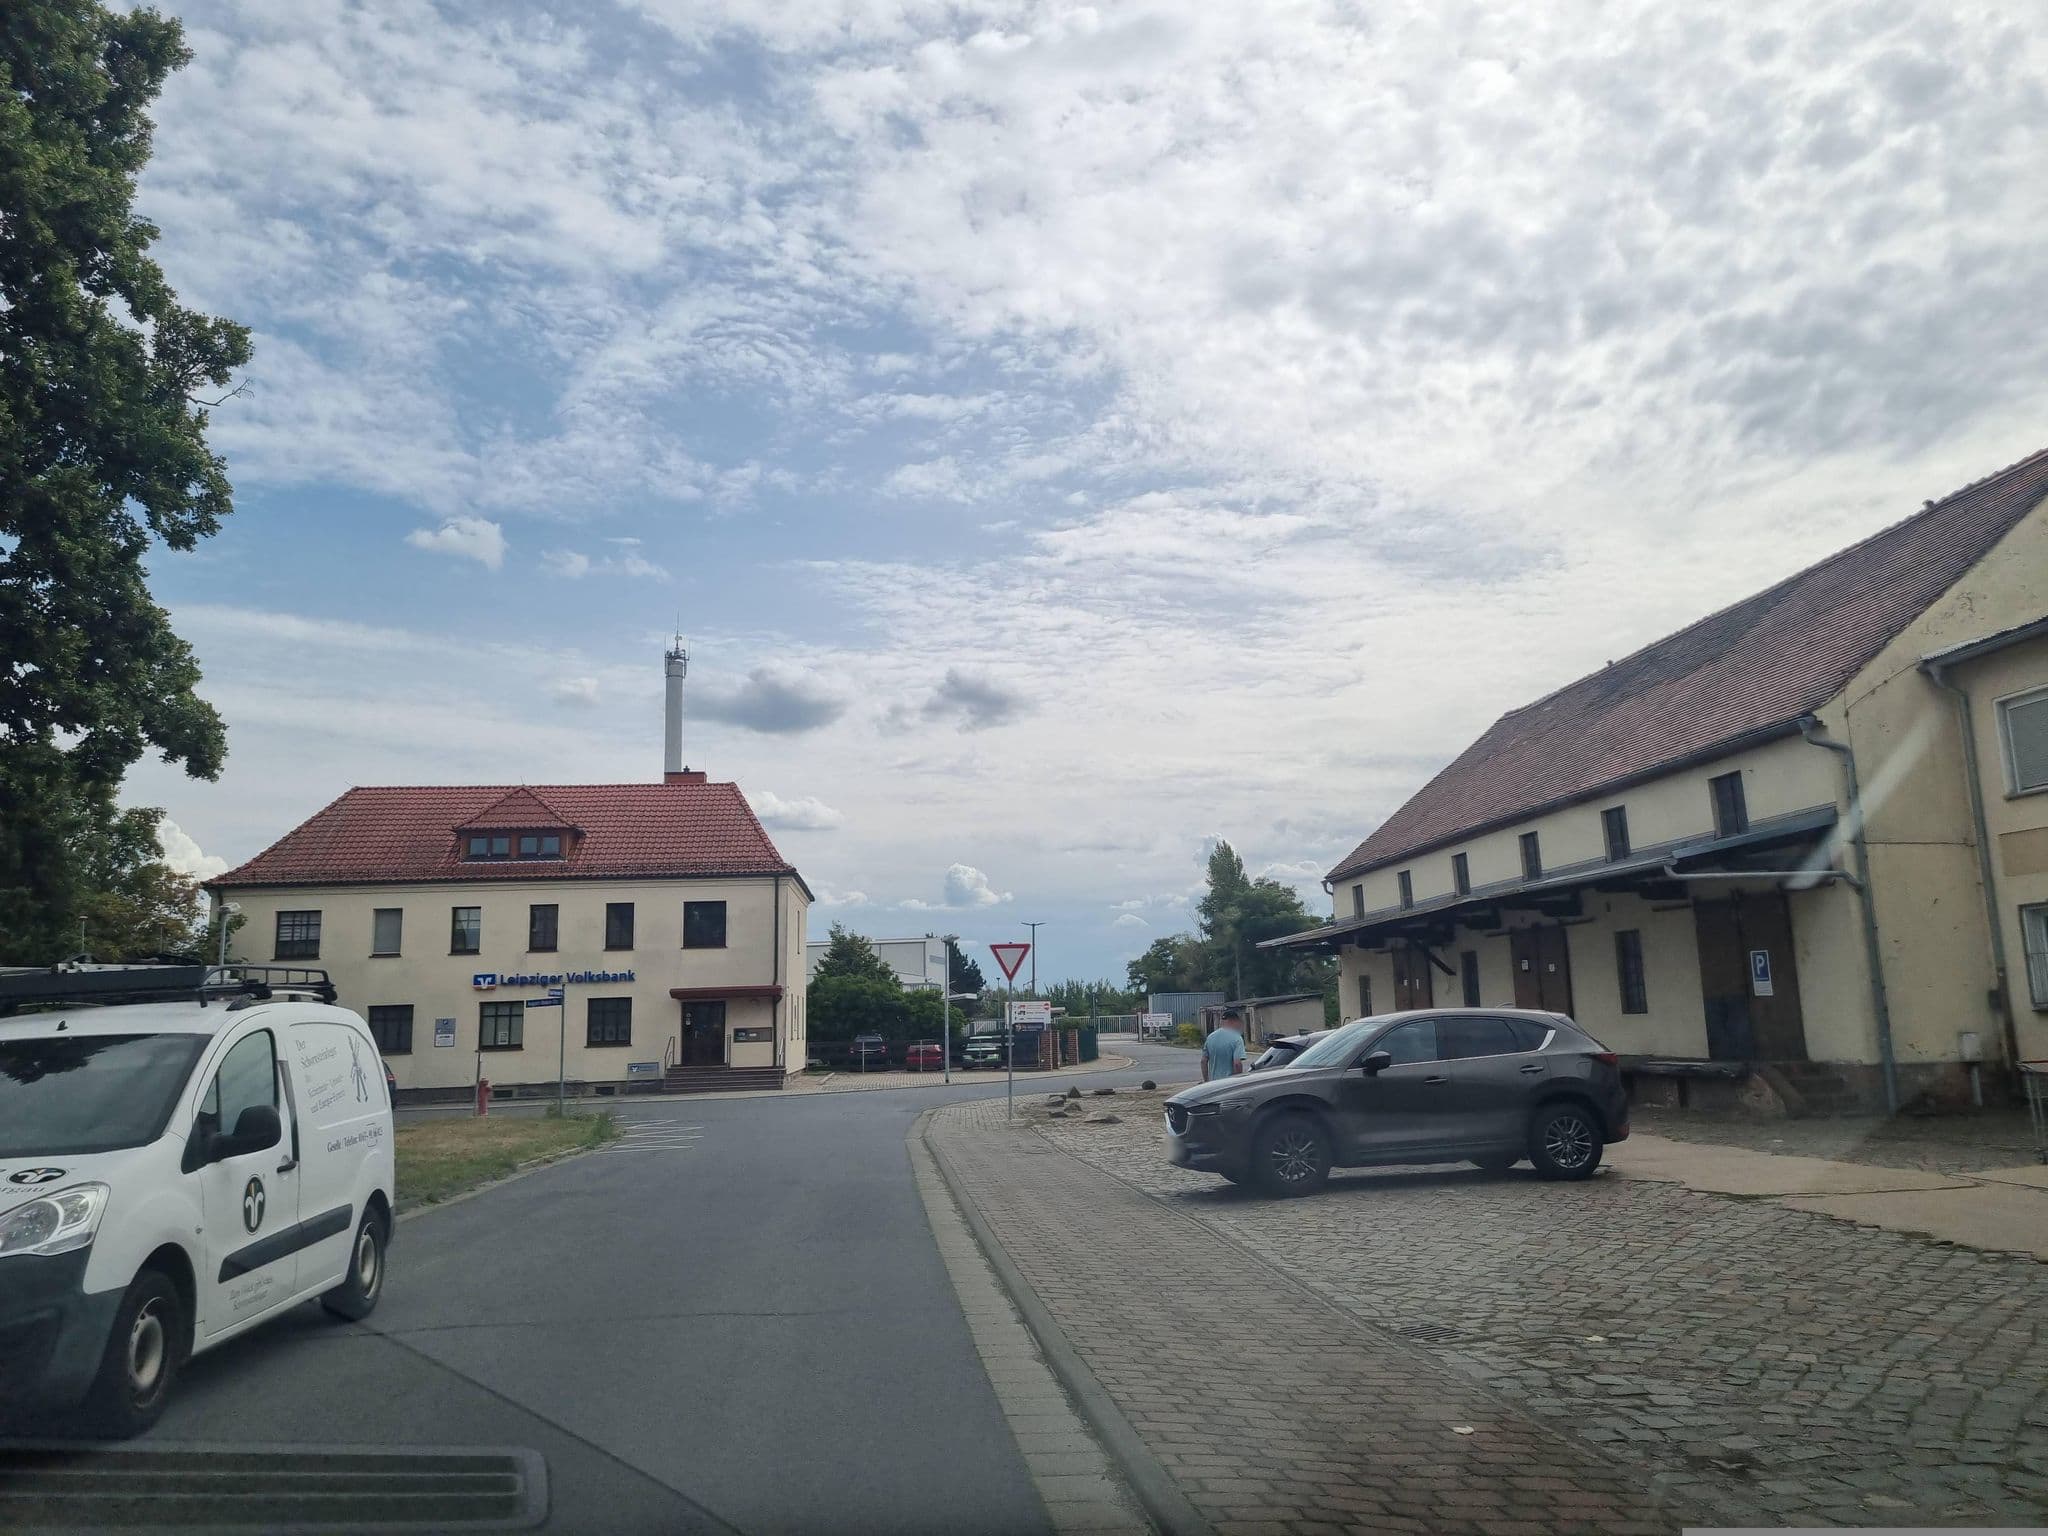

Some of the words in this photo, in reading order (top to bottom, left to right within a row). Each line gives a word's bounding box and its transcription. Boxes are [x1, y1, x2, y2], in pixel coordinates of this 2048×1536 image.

[1756, 955, 1765, 975] P
[500, 973, 563, 988] Leipziger
[566, 970, 636, 983] Volksbank
